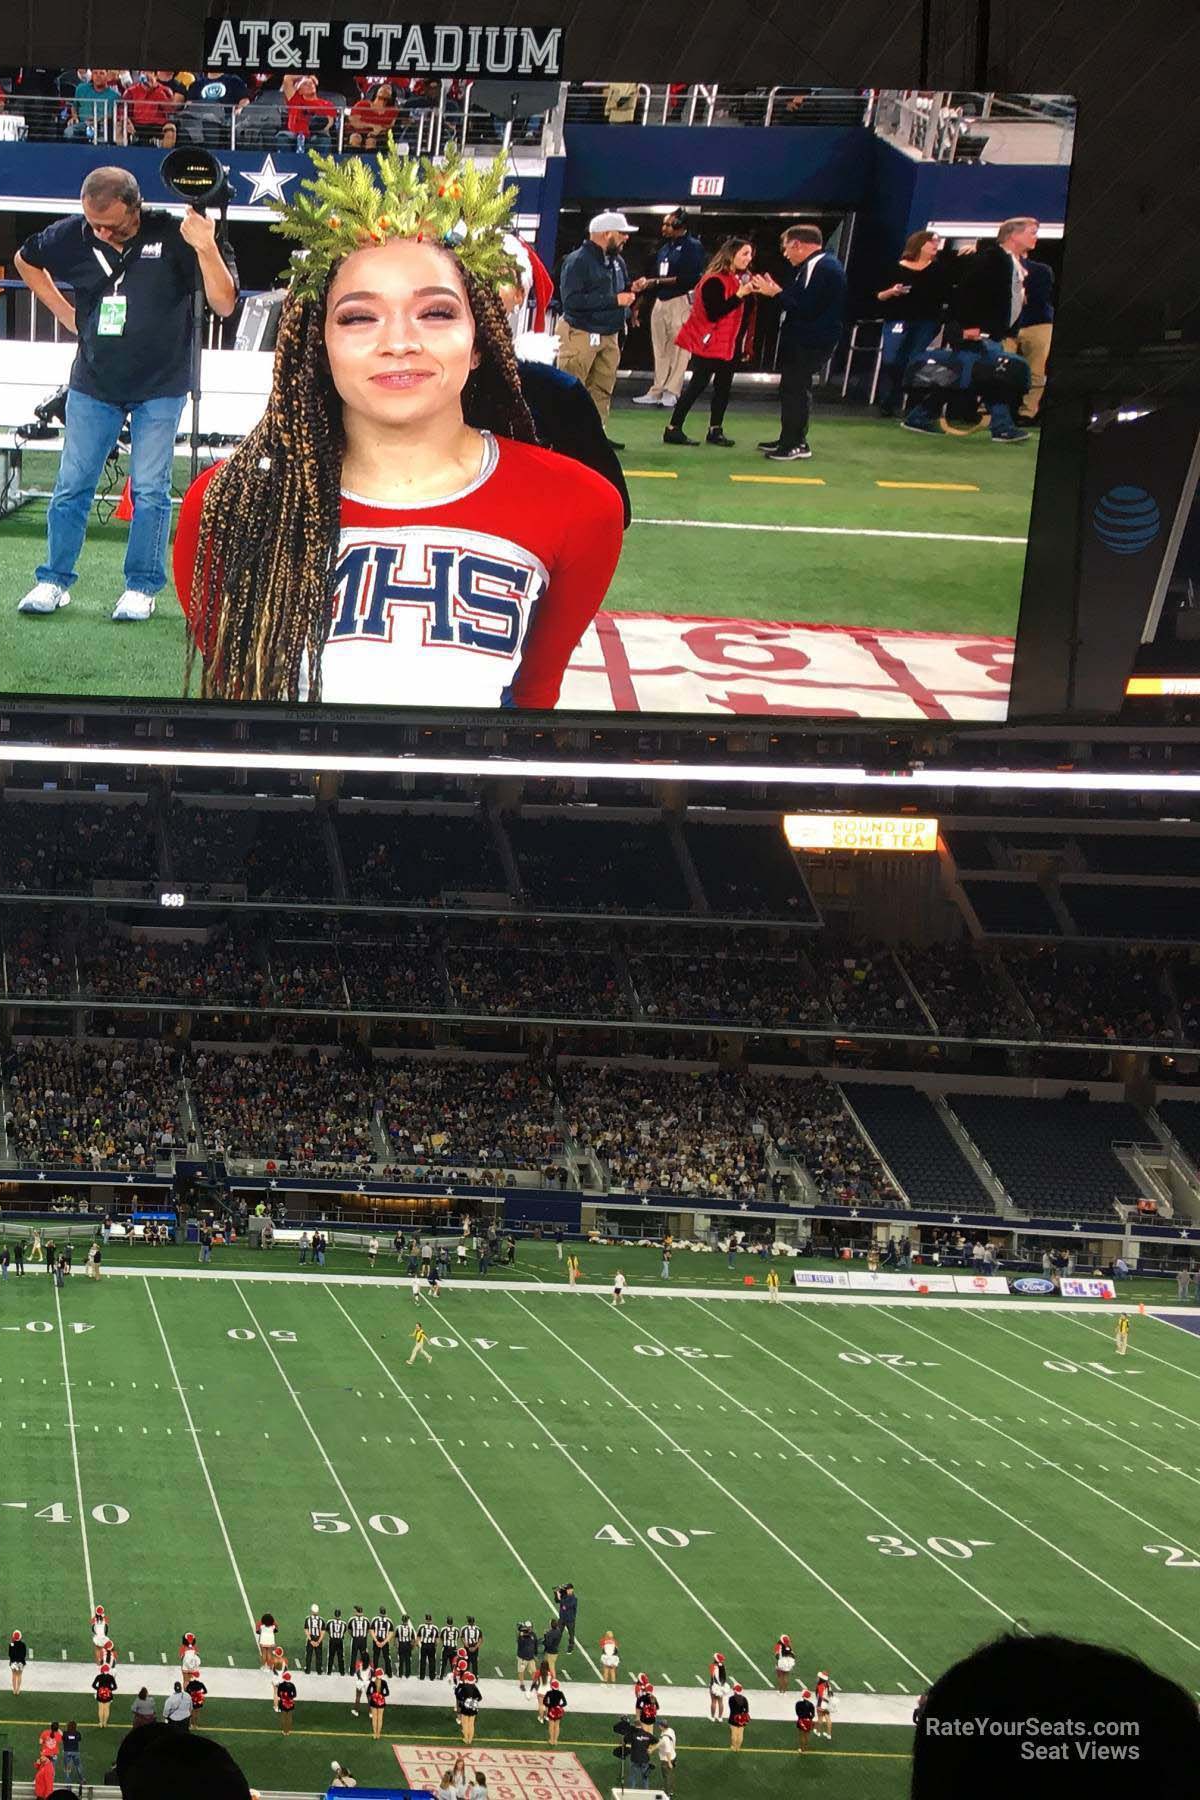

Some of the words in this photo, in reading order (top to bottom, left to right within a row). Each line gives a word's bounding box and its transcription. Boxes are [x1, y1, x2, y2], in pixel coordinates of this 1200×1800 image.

[207, 20, 331, 69] AT&T
[342, 23, 562, 74] STADIUM
[696, 178, 720, 193] EXIT
[833, 821, 894, 833] ROUND
[903, 822, 925, 834] UP
[833, 833, 881, 846] SOME
[892, 835, 923, 847] TEA
[1022, 1281, 1047, 1292] Ford
[33, 1502, 131, 1525] 40
[310, 1511, 410, 1536] 50
[594, 1524, 691, 1548] 40
[865, 1534, 974, 1559] 30
[415, 1750, 496, 1764] HOKA
[504, 1753, 557, 1766] HEY
[415, 1766, 430, 1779] 1
[526, 1771, 544, 1784] 4
[561, 1772, 580, 1785] 5
[496, 1786, 516, 1800] 8
